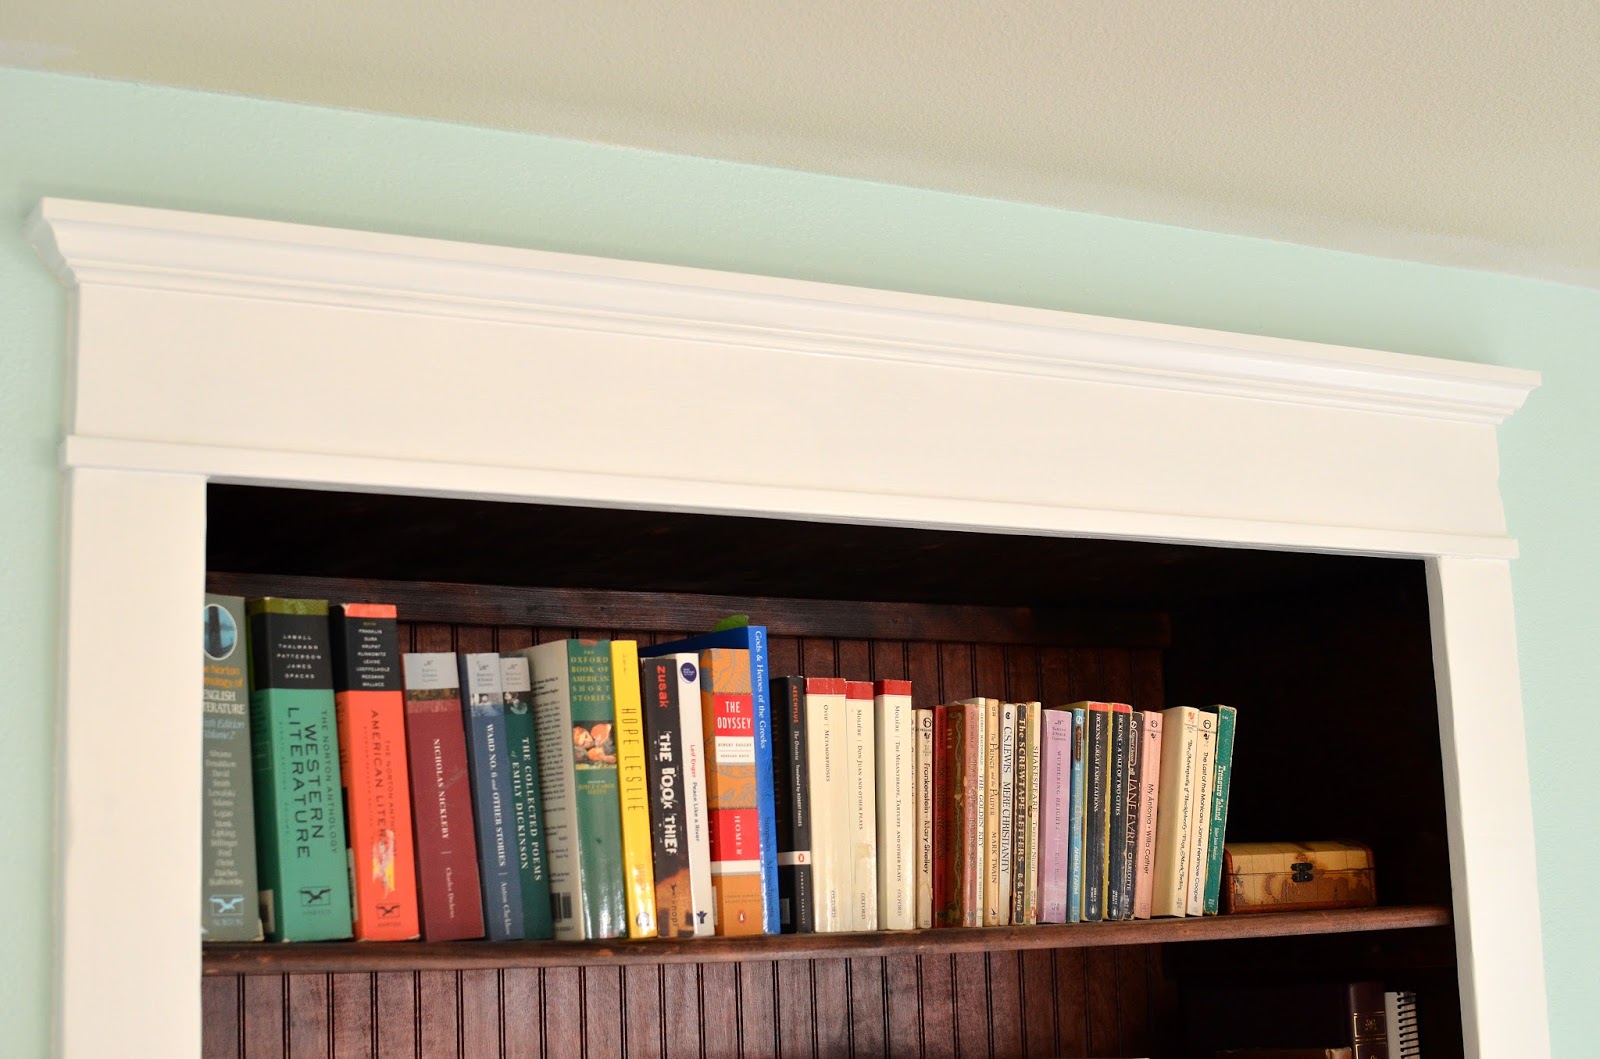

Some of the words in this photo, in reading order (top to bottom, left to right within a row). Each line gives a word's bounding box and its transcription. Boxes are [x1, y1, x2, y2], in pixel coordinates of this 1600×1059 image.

[755, 630, 763, 652] Gods
[656, 665, 670, 708] zusak
[756, 664, 764, 692] Heroes
[203, 690, 236, 701] ENGLISH
[573, 694, 611, 702] STORIES
[725, 701, 741, 713] THE
[758, 694, 765, 702] of
[321, 710, 329, 731] THE
[621, 708, 639, 744] HOPE
[717, 717, 751, 729] ODYSSEY
[759, 720, 767, 749] Greeks
[1018, 718, 1026, 738] The
[371, 709, 383, 787] AMERICAN
[486, 723, 496, 751] WARD
[521, 737, 531, 761] THE
[659, 732, 672, 762] THE
[323, 735, 333, 781] NORTON
[433, 738, 444, 787] NICHOLAS
[489, 753, 498, 769] NO.
[1003, 744, 1012, 773] LEWIS
[1116, 769, 1122, 777] OF
[287, 706, 310, 859] LITERATURE
[304, 724, 325, 838] WESTERN
[386, 761, 394, 798] NORTON
[512, 762, 522, 797] EMILY
[625, 755, 645, 811] LESLIE
[661, 767, 677, 809] BOOK
[923, 763, 931, 813] Frankenstein
[1018, 741, 1026, 810] SCREWTAPE
[1148, 783, 1155, 794] My
[1217, 765, 1226, 796] Treasure
[492, 792, 504, 826] OTHER
[524, 766, 538, 837] COLLECTED
[1003, 782, 1011, 807] MERE
[1128, 778, 1137, 809] JANE
[1198, 793, 1207, 824] Mohicans
[1214, 797, 1224, 821] Island
[327, 786, 338, 853] ANTHOLOGY
[438, 790, 449, 839] NICKLEBY
[1126, 814, 1136, 846] EYRE
[515, 803, 529, 870] DICKINSON
[664, 813, 678, 855] THIEF
[734, 815, 742, 855] HOMER
[763, 816, 772, 852] Simpson
[922, 820, 931, 842] Mary
[1001, 808, 1011, 874] CHRISTIANITY
[1017, 814, 1025, 862] LETTERS
[495, 827, 507, 867] STORIES
[531, 841, 542, 881] POEMS
[922, 844, 931, 874] Shelley
[445, 867, 454, 892] Charles
[500, 882, 509, 903] Anton
[1192, 877, 1200, 903] Cooper
[447, 892, 456, 919] Dickens
